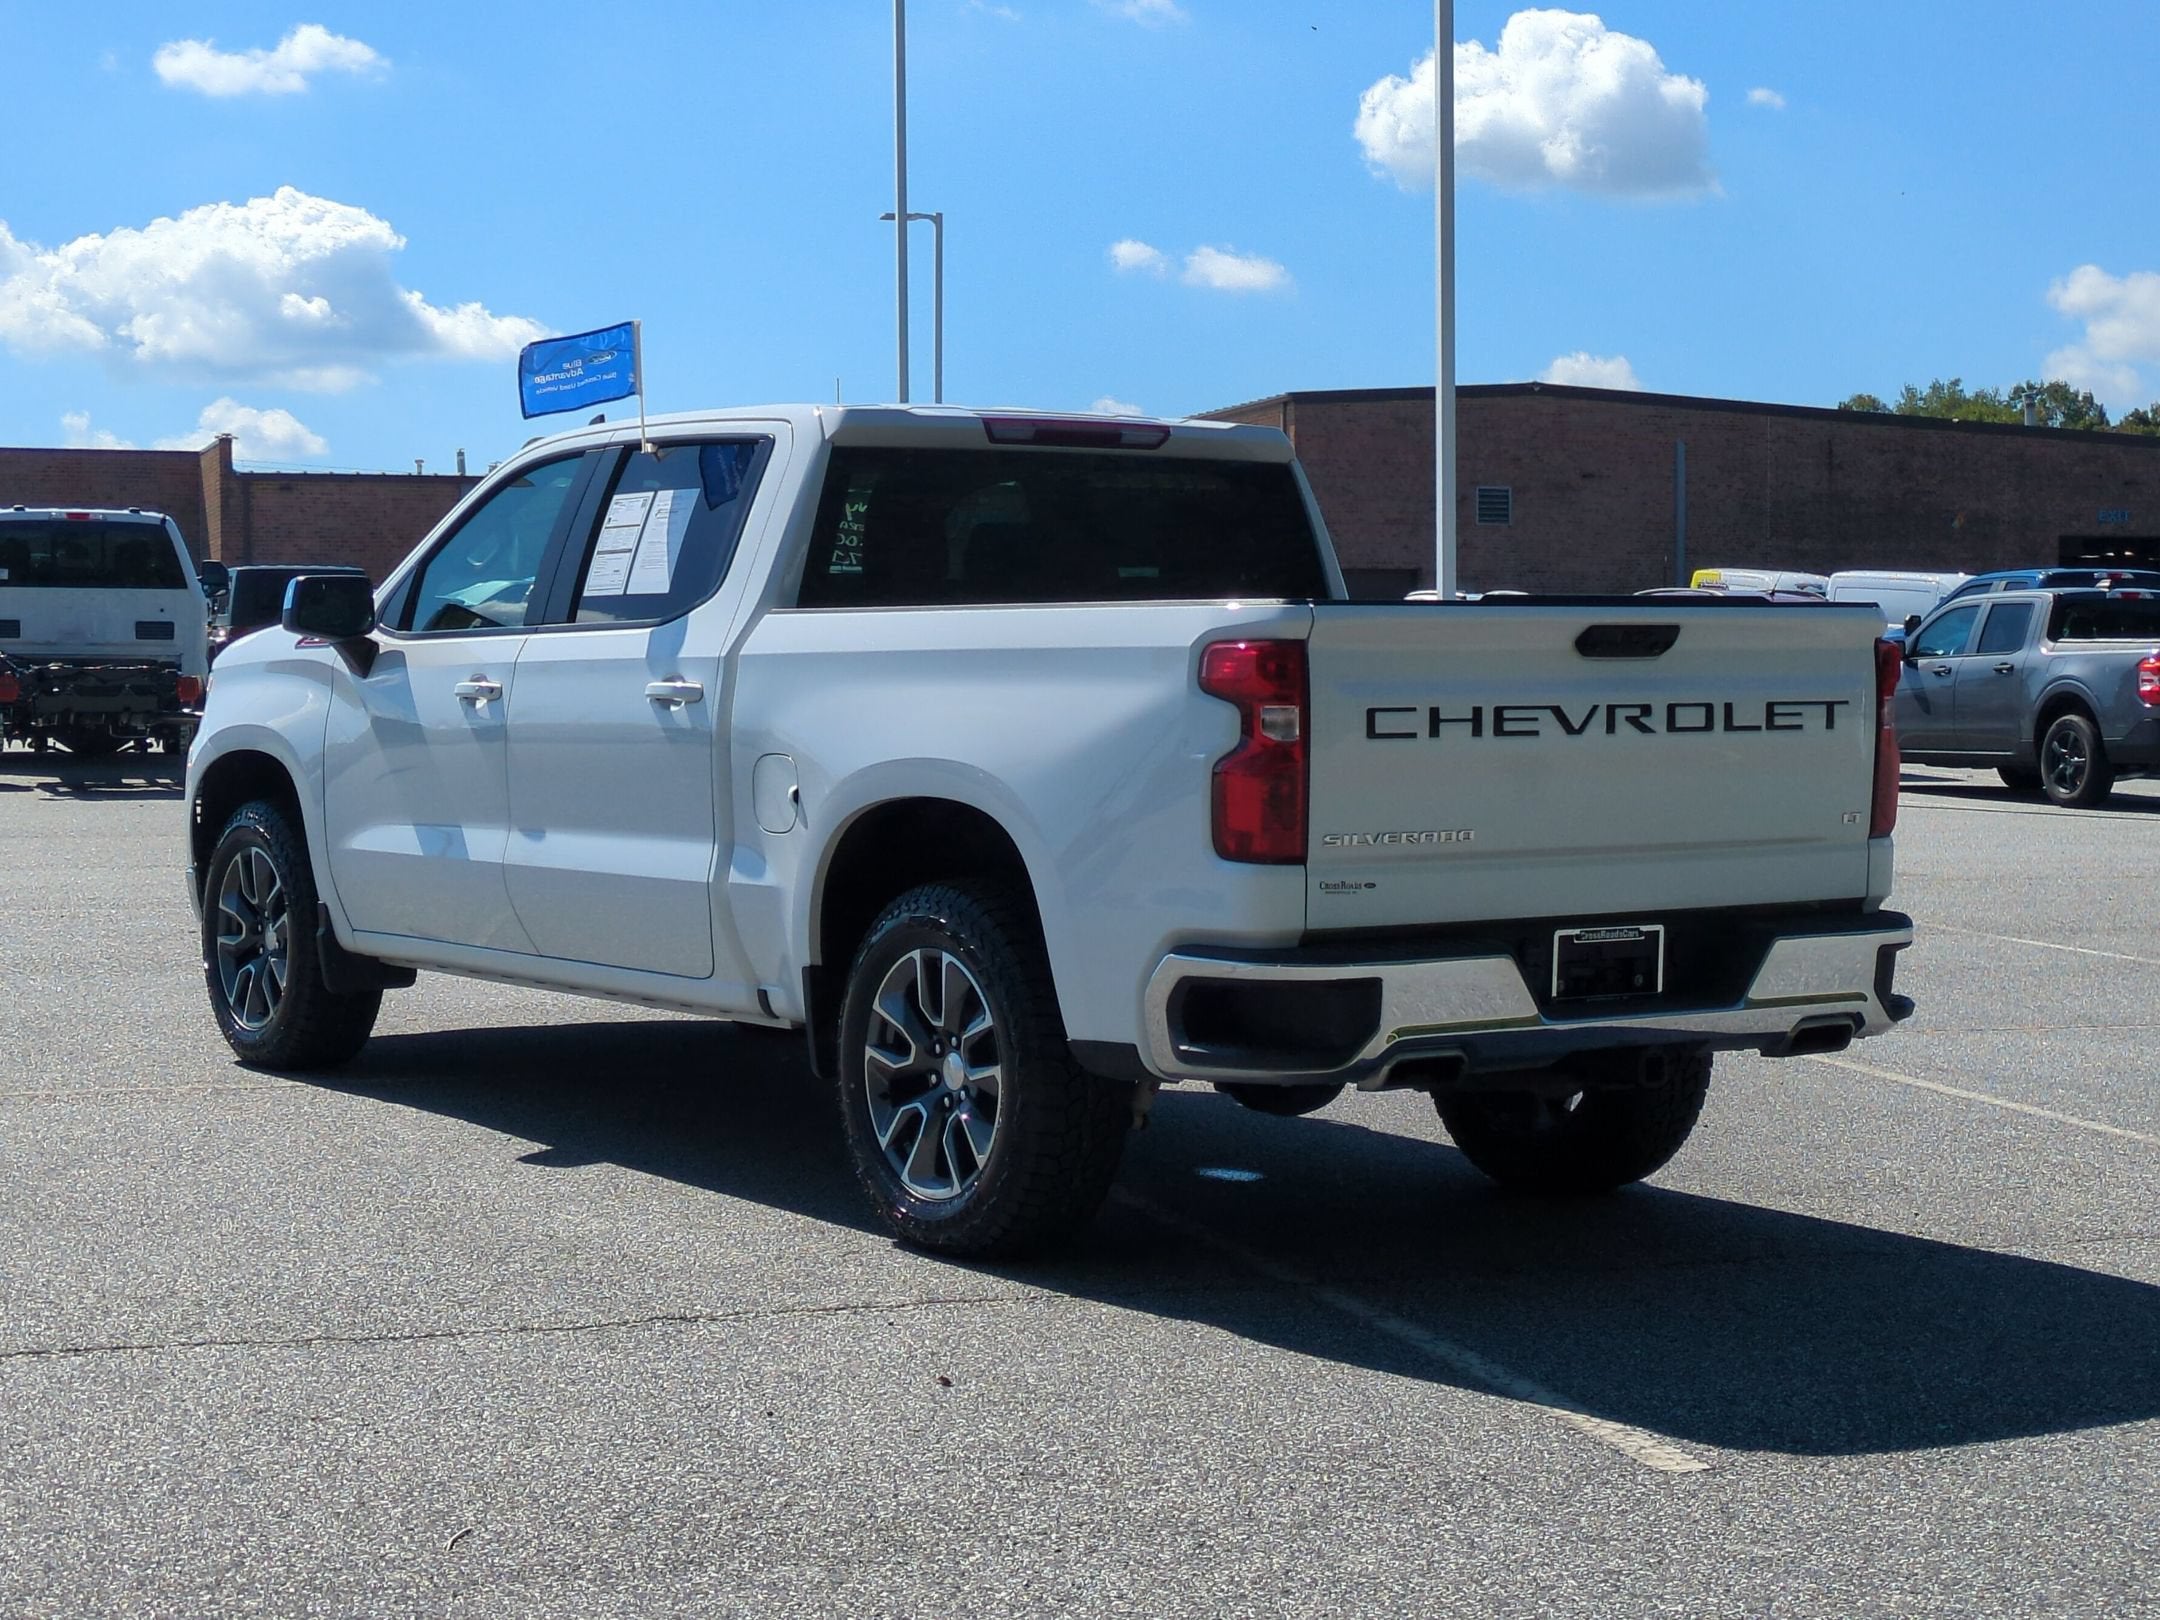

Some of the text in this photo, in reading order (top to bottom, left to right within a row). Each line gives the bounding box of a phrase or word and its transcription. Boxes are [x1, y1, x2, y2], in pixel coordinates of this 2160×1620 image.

[1366, 700, 1849, 740] CHEVROLET
[1842, 811, 1861, 825] LT
[1322, 829, 1475, 847] SILVERADO
